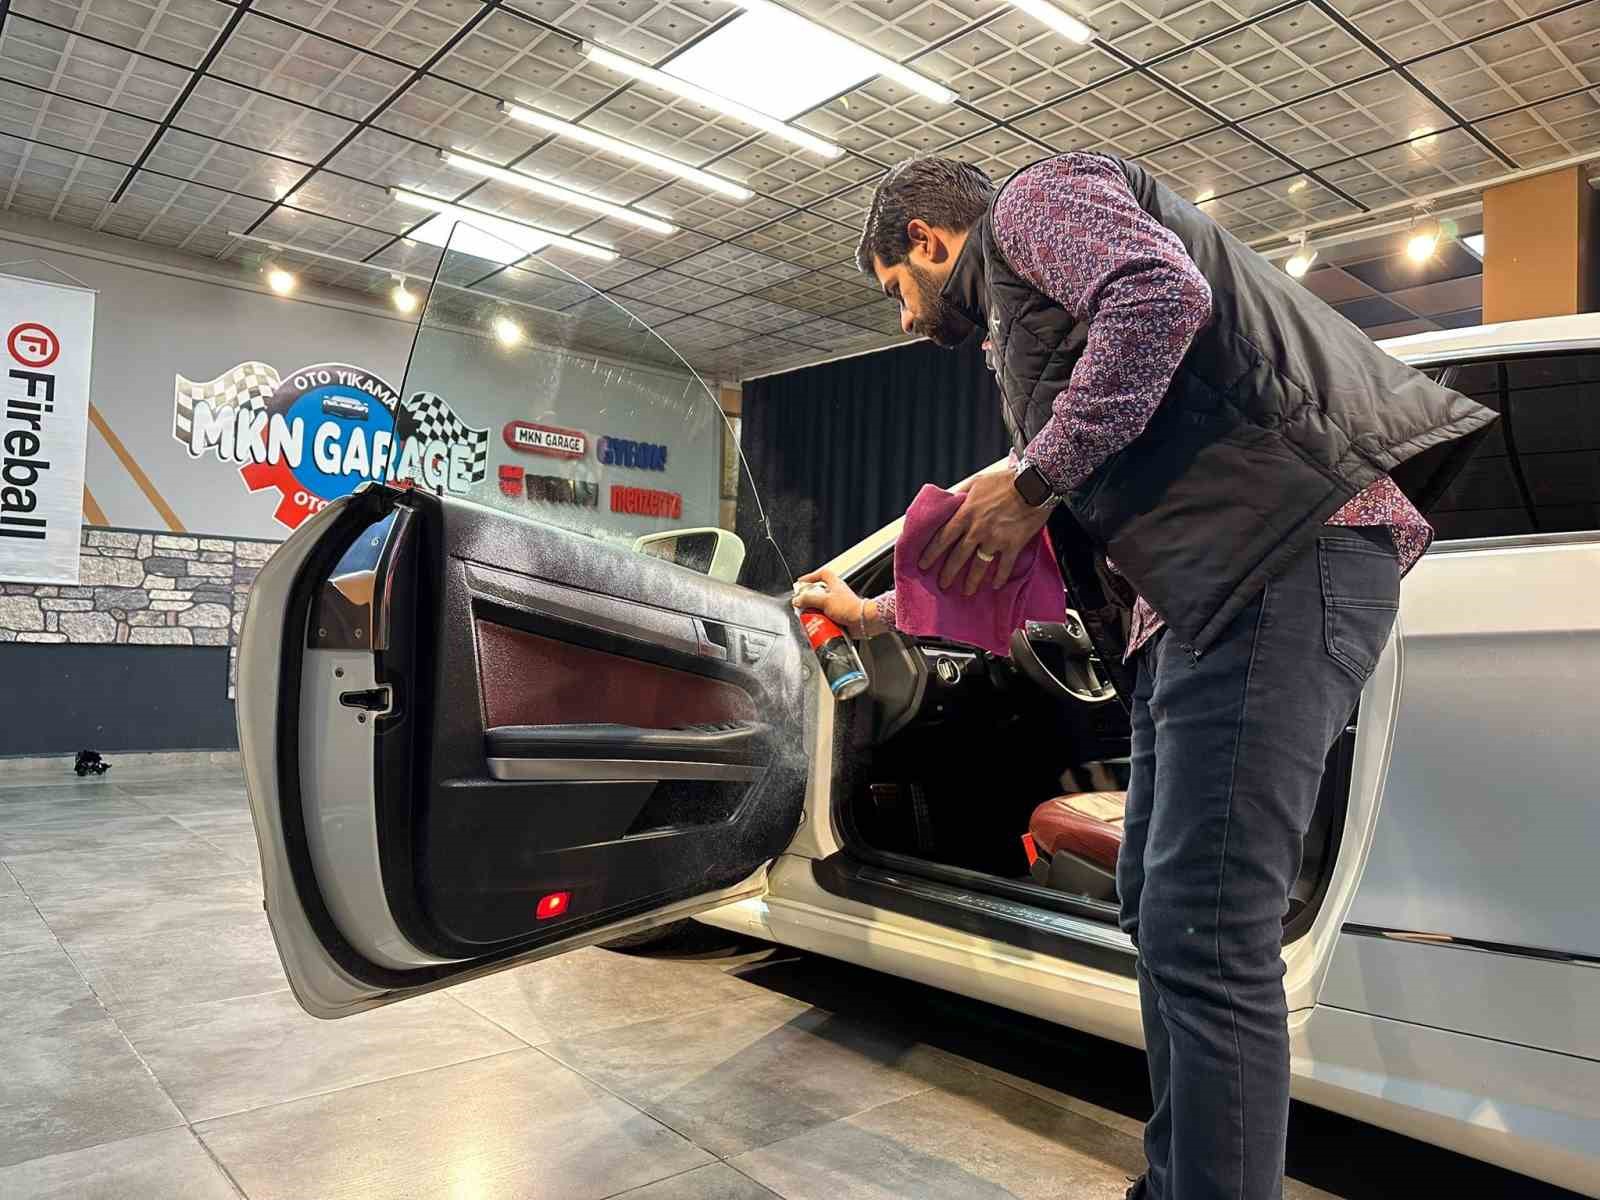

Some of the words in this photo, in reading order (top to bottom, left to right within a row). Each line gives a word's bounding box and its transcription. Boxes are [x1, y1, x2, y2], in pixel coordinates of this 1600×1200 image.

[294, 370, 331, 391] OTO
[336, 370, 400, 411] YIKAMA
[0, 368, 55, 540] Fireball
[187, 399, 305, 468] MKN
[313, 420, 475, 494] GARAGE
[519, 428, 542, 444] MKN
[545, 434, 581, 451] GARAGE
